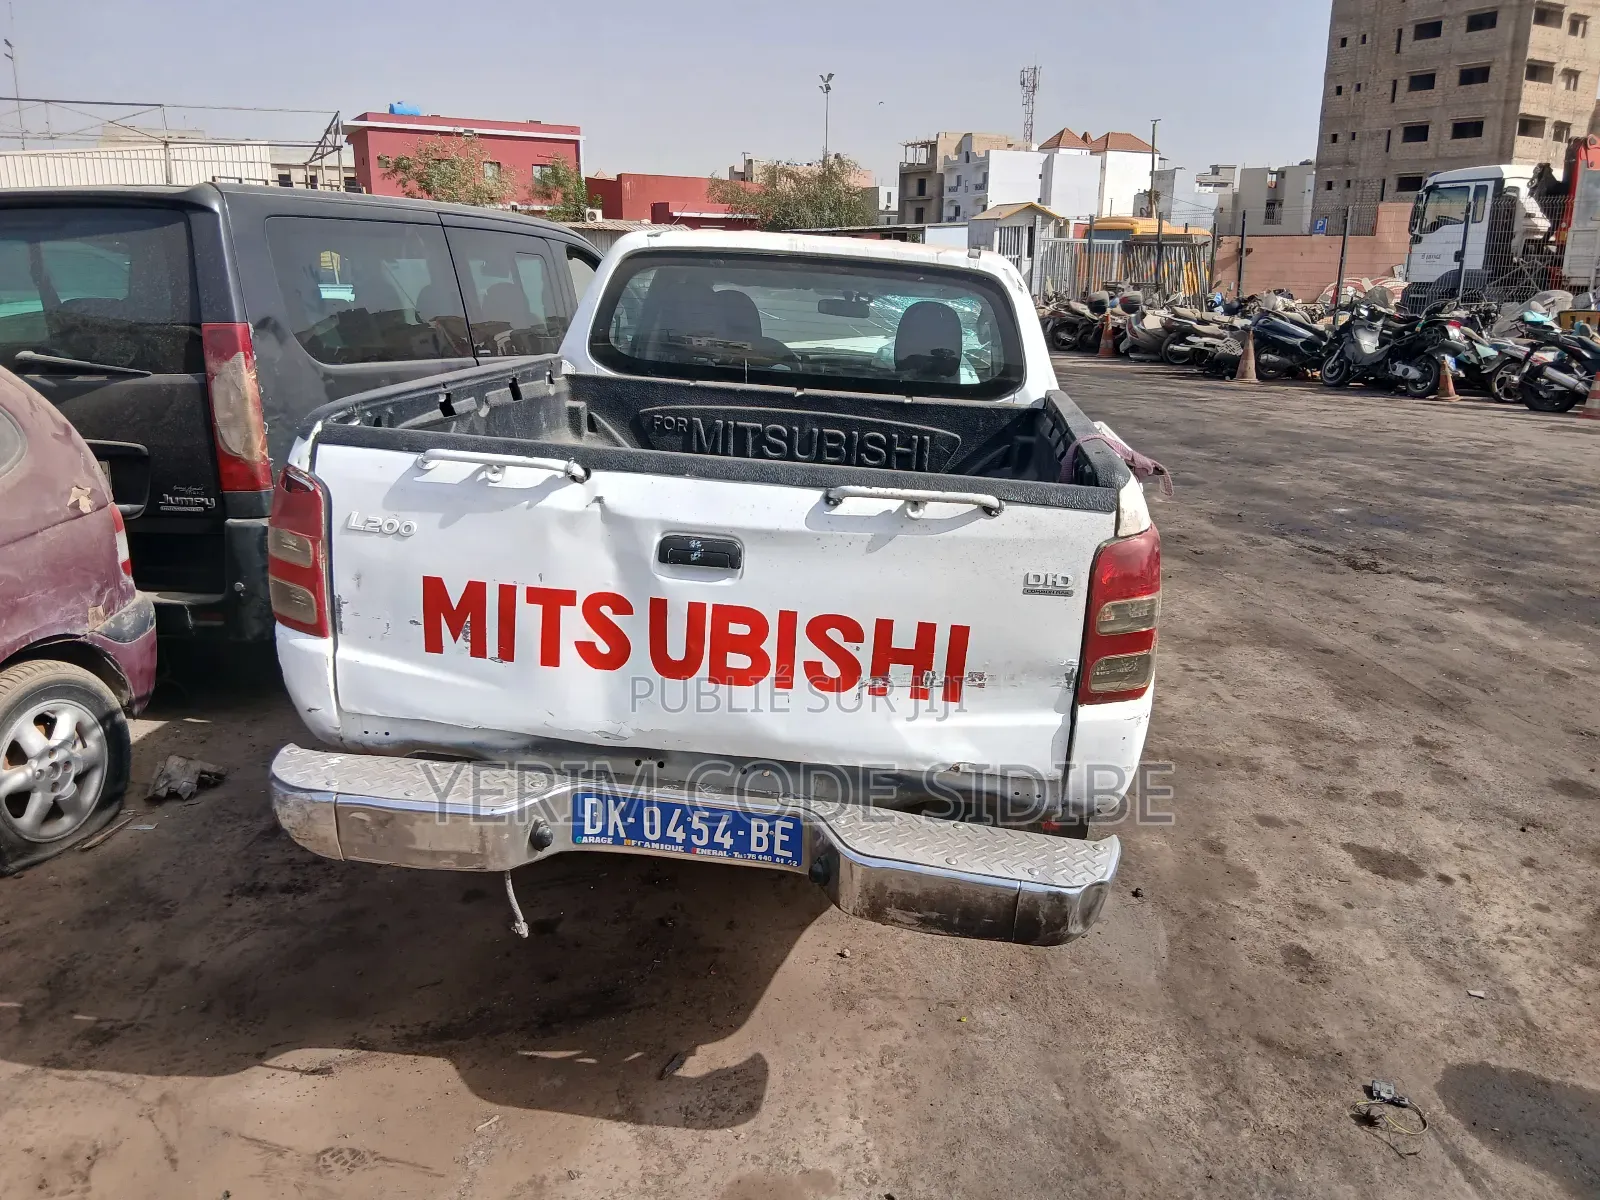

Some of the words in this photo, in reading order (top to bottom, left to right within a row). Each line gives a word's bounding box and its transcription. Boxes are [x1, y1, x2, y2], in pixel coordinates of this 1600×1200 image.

[1316, 220, 1324, 230] P
[653, 414, 688, 433] FOR
[692, 417, 931, 472] MITSUBISHI
[346, 510, 418, 538] L200
[422, 575, 971, 703] MITSUBISHI
[575, 835, 613, 845] GARAGE
[583, 797, 794, 858] DK-0454-BE
